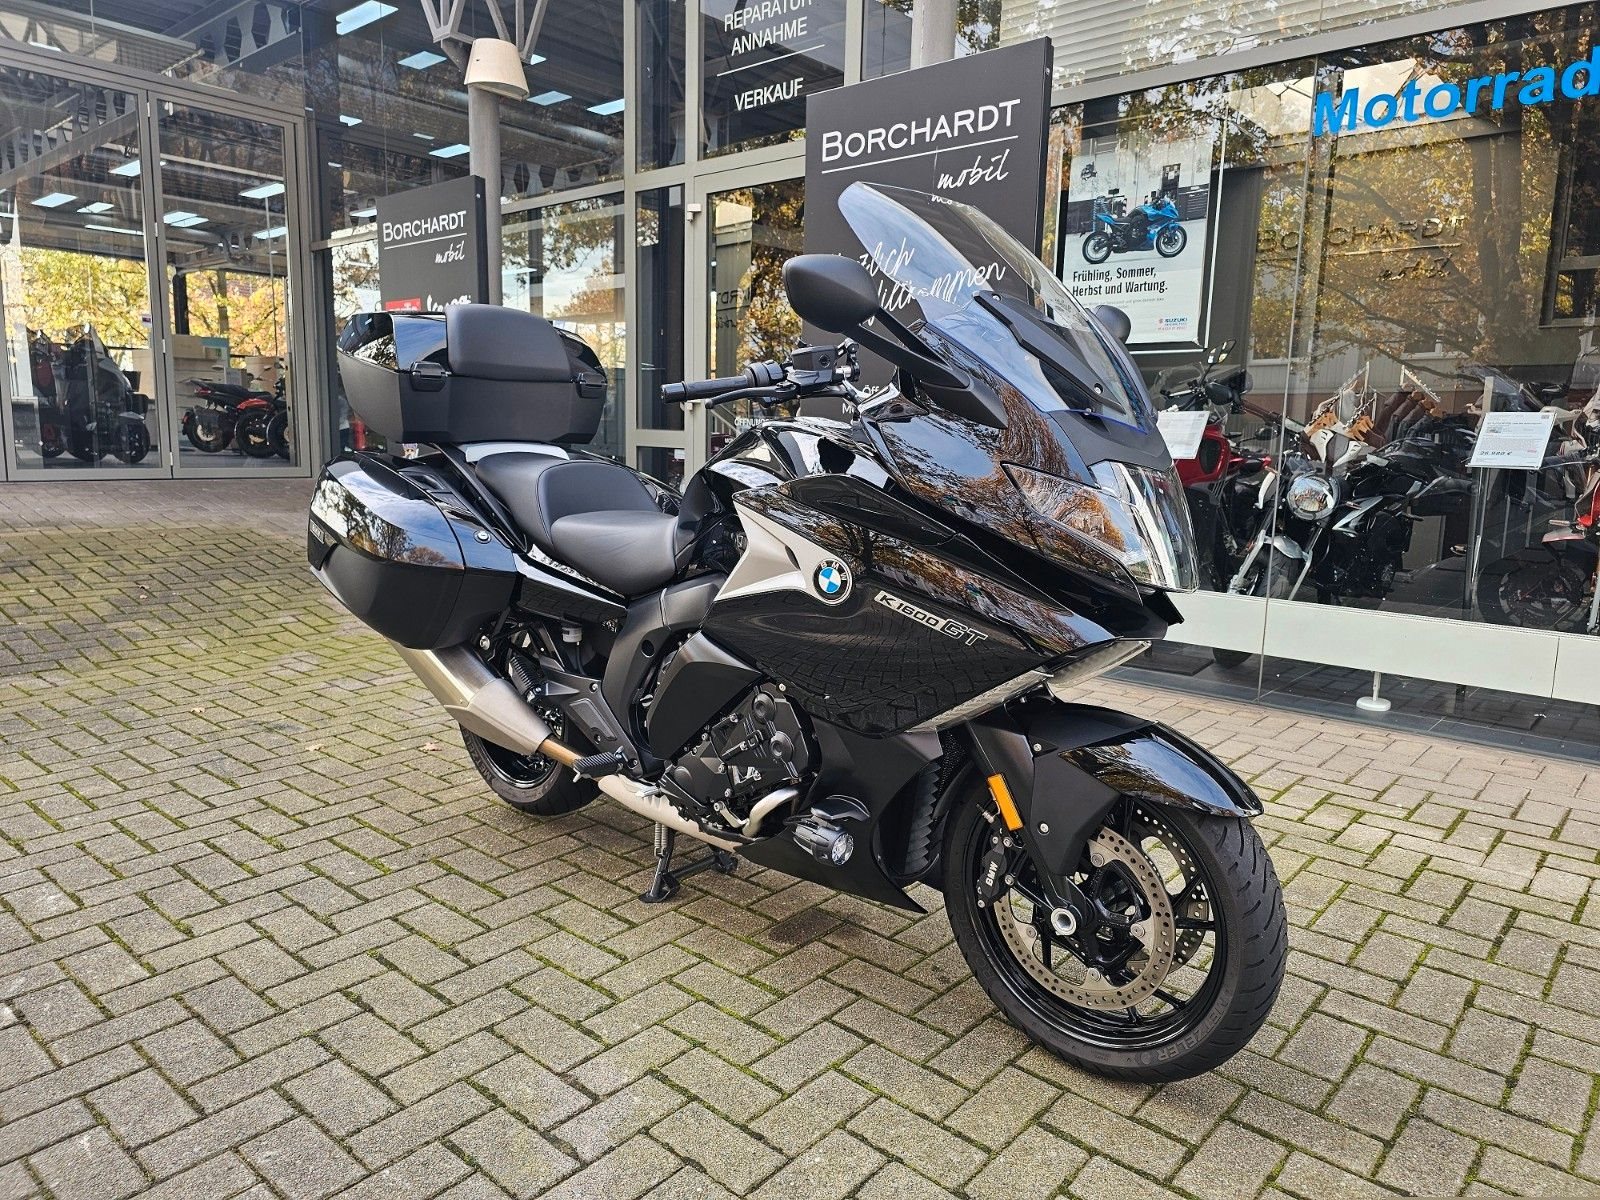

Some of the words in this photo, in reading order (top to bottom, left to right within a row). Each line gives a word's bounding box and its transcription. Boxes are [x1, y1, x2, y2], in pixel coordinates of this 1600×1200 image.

[731, 16, 808, 56] ANNAHME
[734, 77, 804, 111] VERKAUF
[1313, 46, 1600, 137] Motorrad
[821, 98, 1021, 163] BORCHARDT
[937, 148, 1010, 190] mobil
[382, 210, 467, 243] BORCHARDT
[434, 240, 465, 264] mobil
[1072, 270, 1113, 283] Frühling,
[1116, 266, 1156, 279] Sommer,
[1072, 284, 1102, 297] Herbst
[1105, 282, 1122, 295] und
[1125, 280, 1168, 294] Wartung.
[879, 594, 896, 606] K
[896, 602, 940, 628] 1600
[940, 618, 988, 646] GT
[985, 861, 998, 887] BMW
